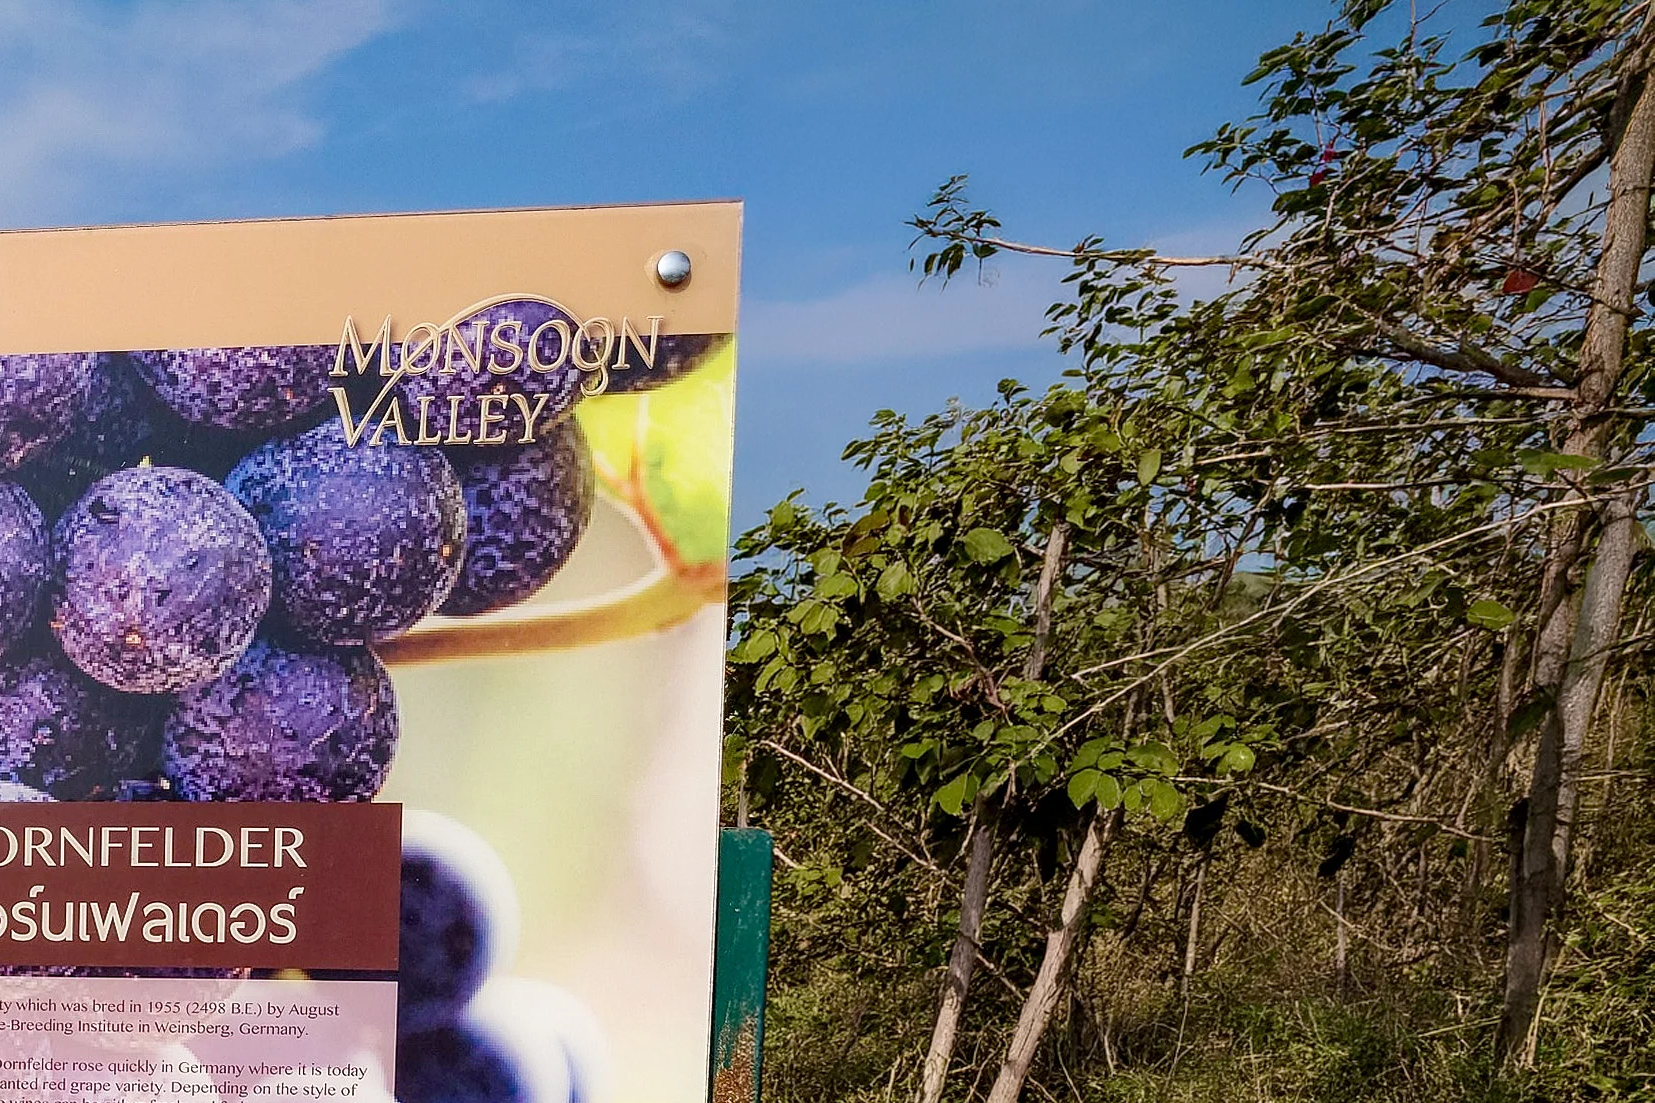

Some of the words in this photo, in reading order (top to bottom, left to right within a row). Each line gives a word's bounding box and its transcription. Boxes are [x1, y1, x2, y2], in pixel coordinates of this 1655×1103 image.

[329, 313, 665, 378] MONSOON
[328, 386, 550, 448] VALLEY
[16, 999, 56, 1012] which
[61, 1002, 88, 1012] was
[93, 999, 125, 1013] bred
[130, 1001, 142, 1013] in
[148, 1002, 181, 1013] 1955
[186, 1002, 226, 1016] (2498
[231, 1003, 262, 1017] B.E.)
[268, 1002, 284, 1018] by
[289, 1004, 339, 1019] August
[78, 1020, 133, 1033] Institute
[139, 1021, 150, 1032] in
[155, 1021, 234, 1037] Weinsberg,
[239, 1023, 308, 1038] Germany.
[73, 1061, 103, 1071] rose
[108, 1060, 157, 1076] quickly
[162, 1061, 173, 1073] in
[178, 1061, 244, 1077] Germany
[249, 1063, 293, 1075] where
[298, 1062, 306, 1075] it
[311, 1063, 322, 1076] is
[327, 1063, 367, 1079] today
[42, 1078, 66, 1091] red
[71, 1081, 110, 1094] grape
[116, 1081, 166, 1094] variety.
[171, 1081, 247, 1096] Depending
[253, 1084, 271, 1095] on
[276, 1084, 298, 1095] the
[303, 1084, 336, 1098] style
[341, 1084, 358, 1096] of
